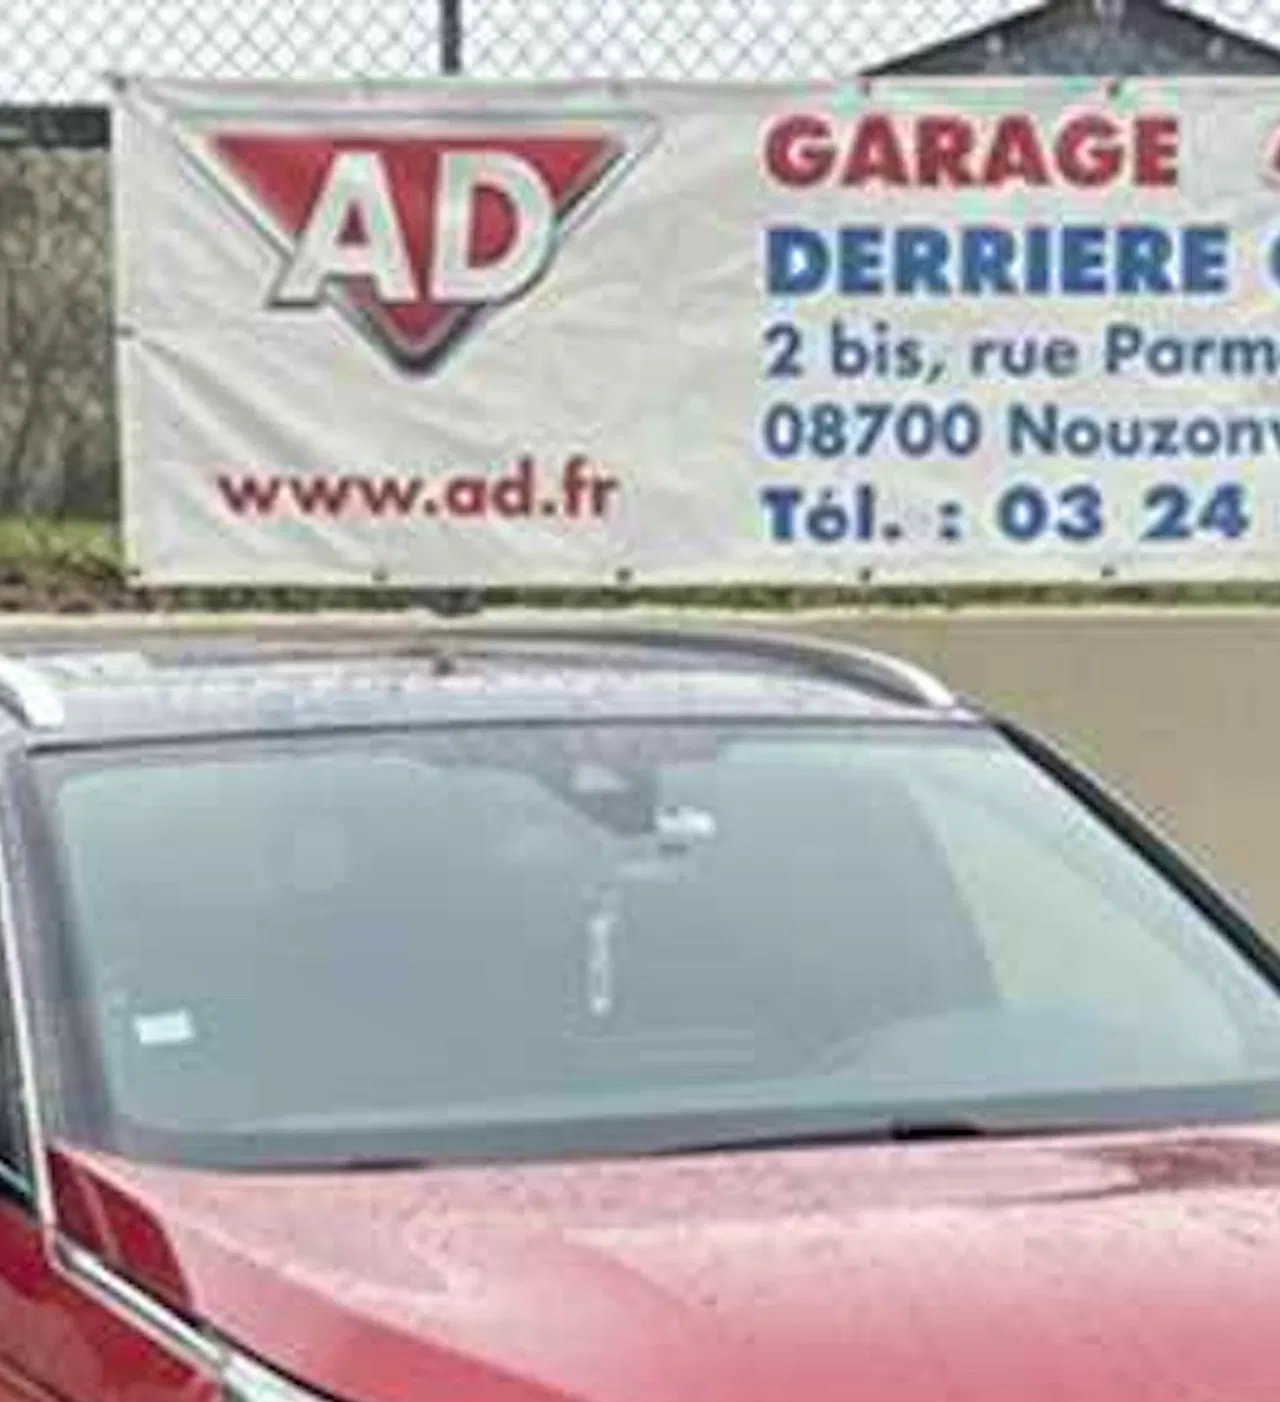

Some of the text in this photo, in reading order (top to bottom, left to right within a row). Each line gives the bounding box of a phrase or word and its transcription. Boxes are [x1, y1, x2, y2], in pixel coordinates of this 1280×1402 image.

[763, 115, 1179, 189] GARAGE
[270, 148, 560, 304] AD
[764, 224, 1231, 297] DERRIERE
[764, 323, 803, 379] 2
[831, 320, 945, 384] bis,
[971, 338, 1080, 379] rue
[765, 404, 982, 457] 08700
[220, 458, 618, 519] www.ad.fr
[997, 484, 1104, 541] 03
[1139, 484, 1249, 540] 24
